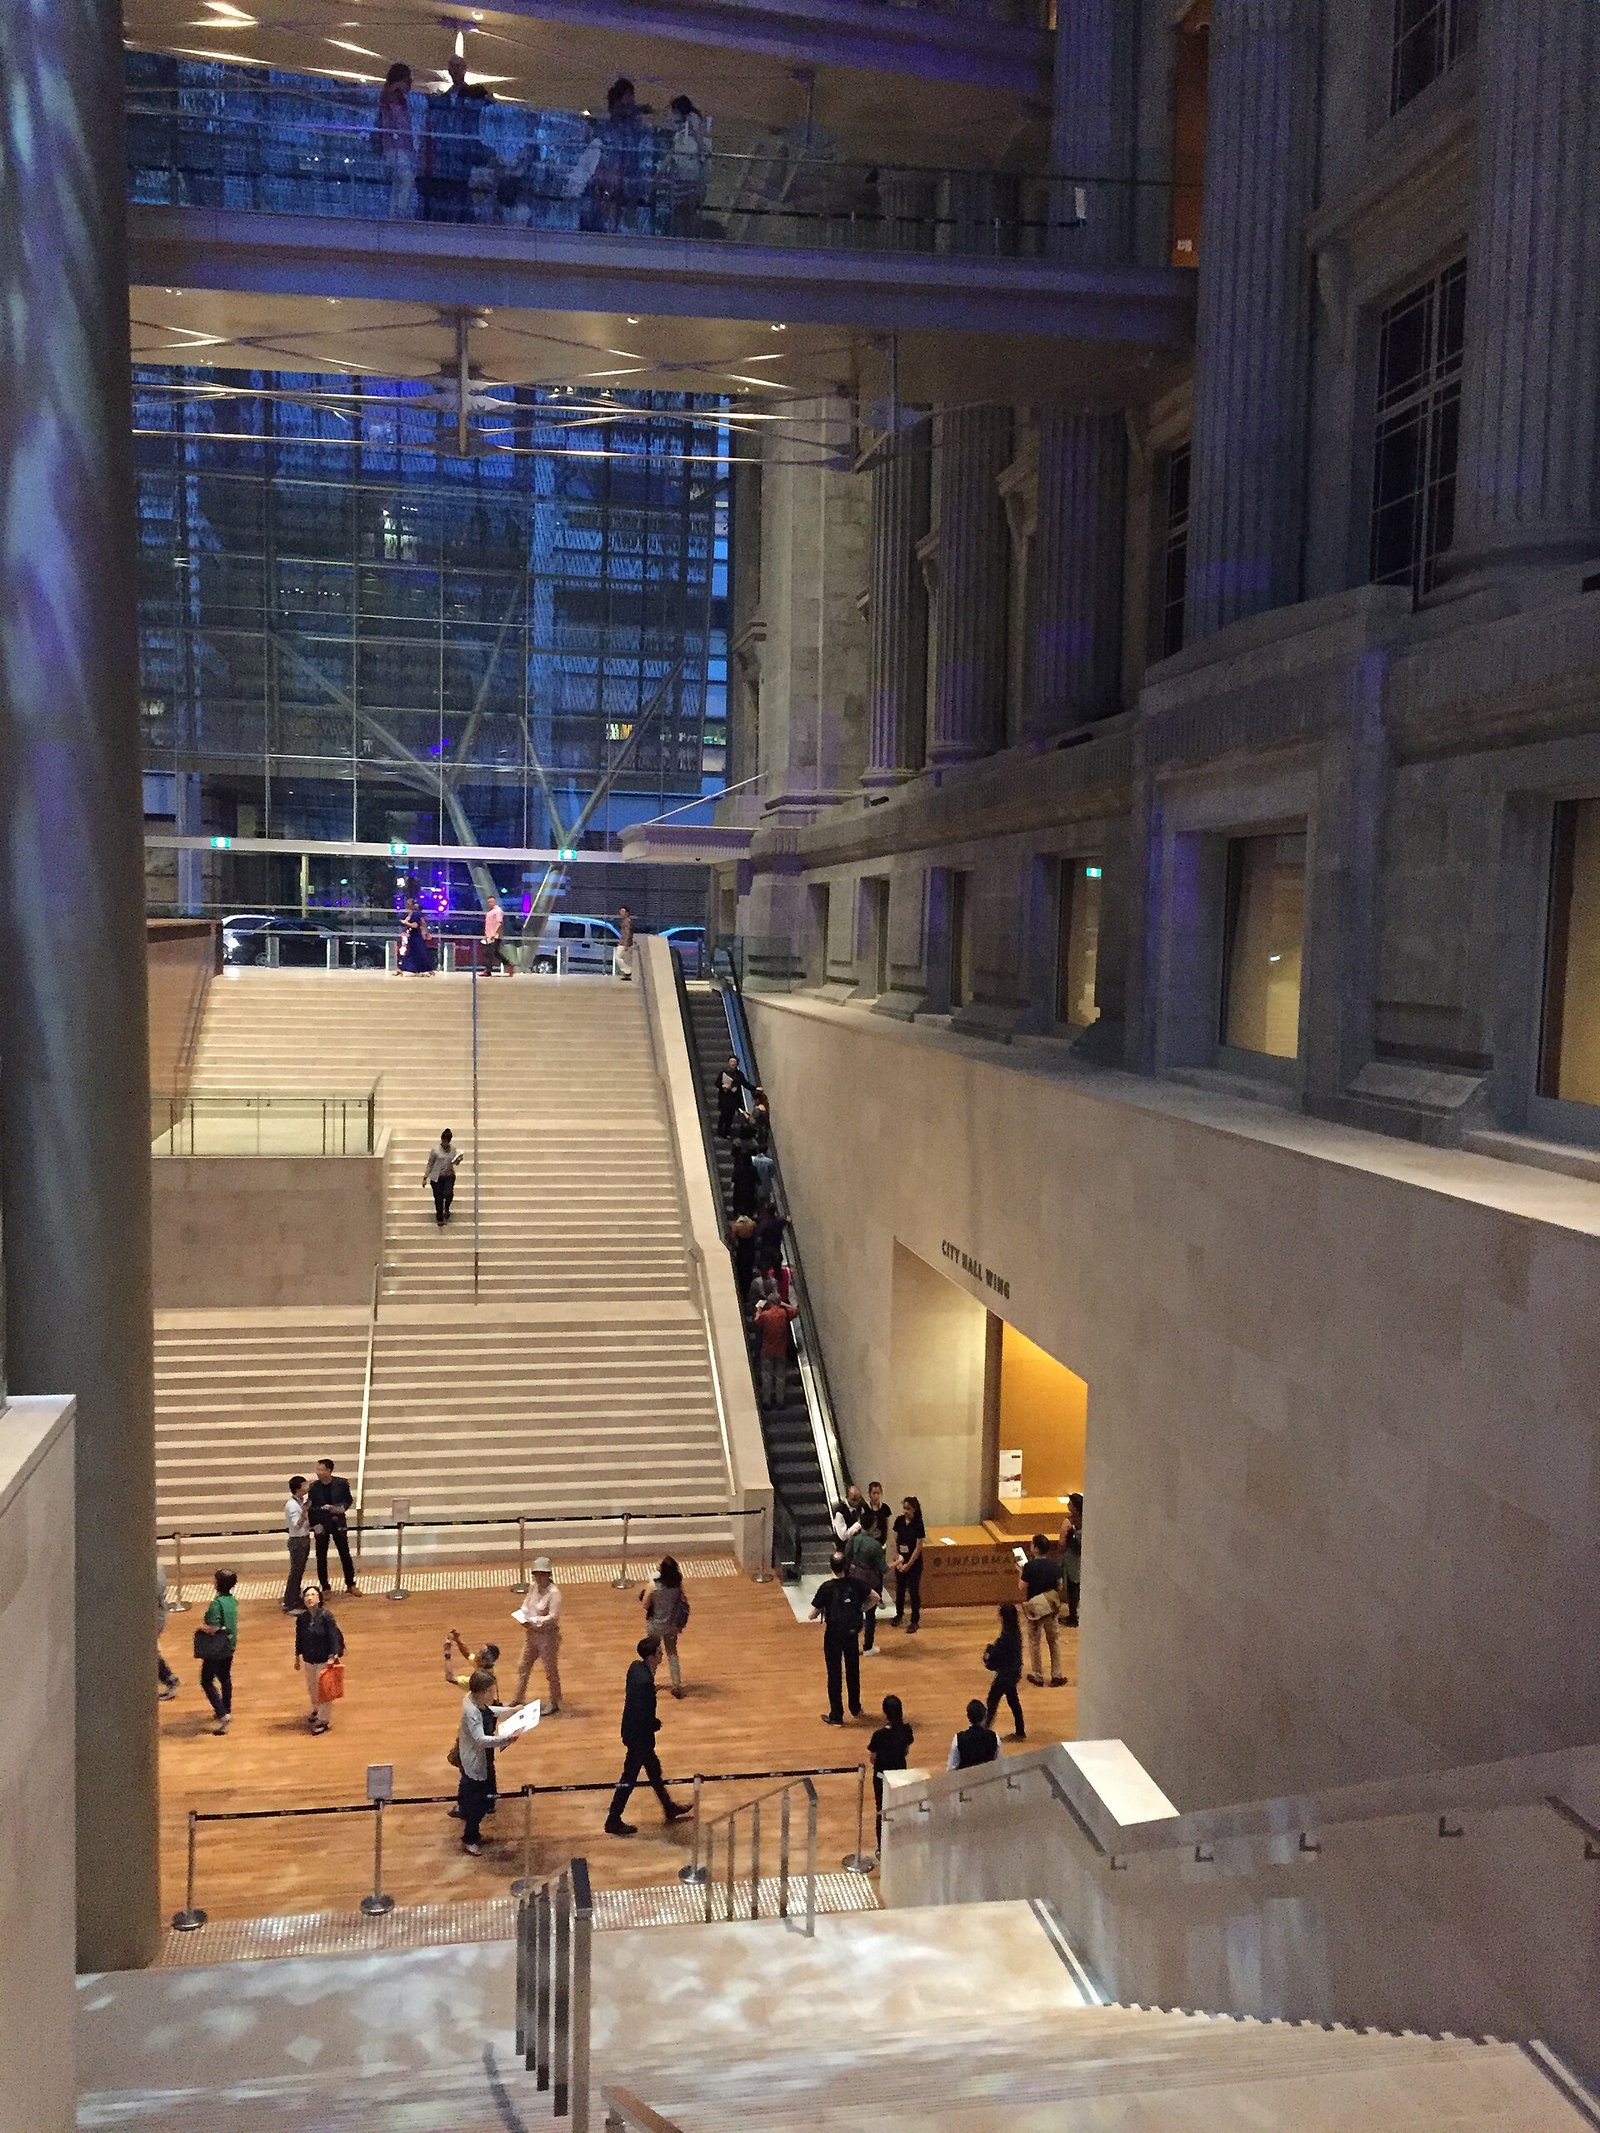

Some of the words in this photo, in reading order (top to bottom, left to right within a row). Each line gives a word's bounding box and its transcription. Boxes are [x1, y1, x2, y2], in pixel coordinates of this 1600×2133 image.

[942, 1239, 960, 1264] CITY
[962, 1252, 982, 1282] HALL
[985, 1268, 1010, 1300] WING
[947, 1555, 1012, 1567] INFORMA
